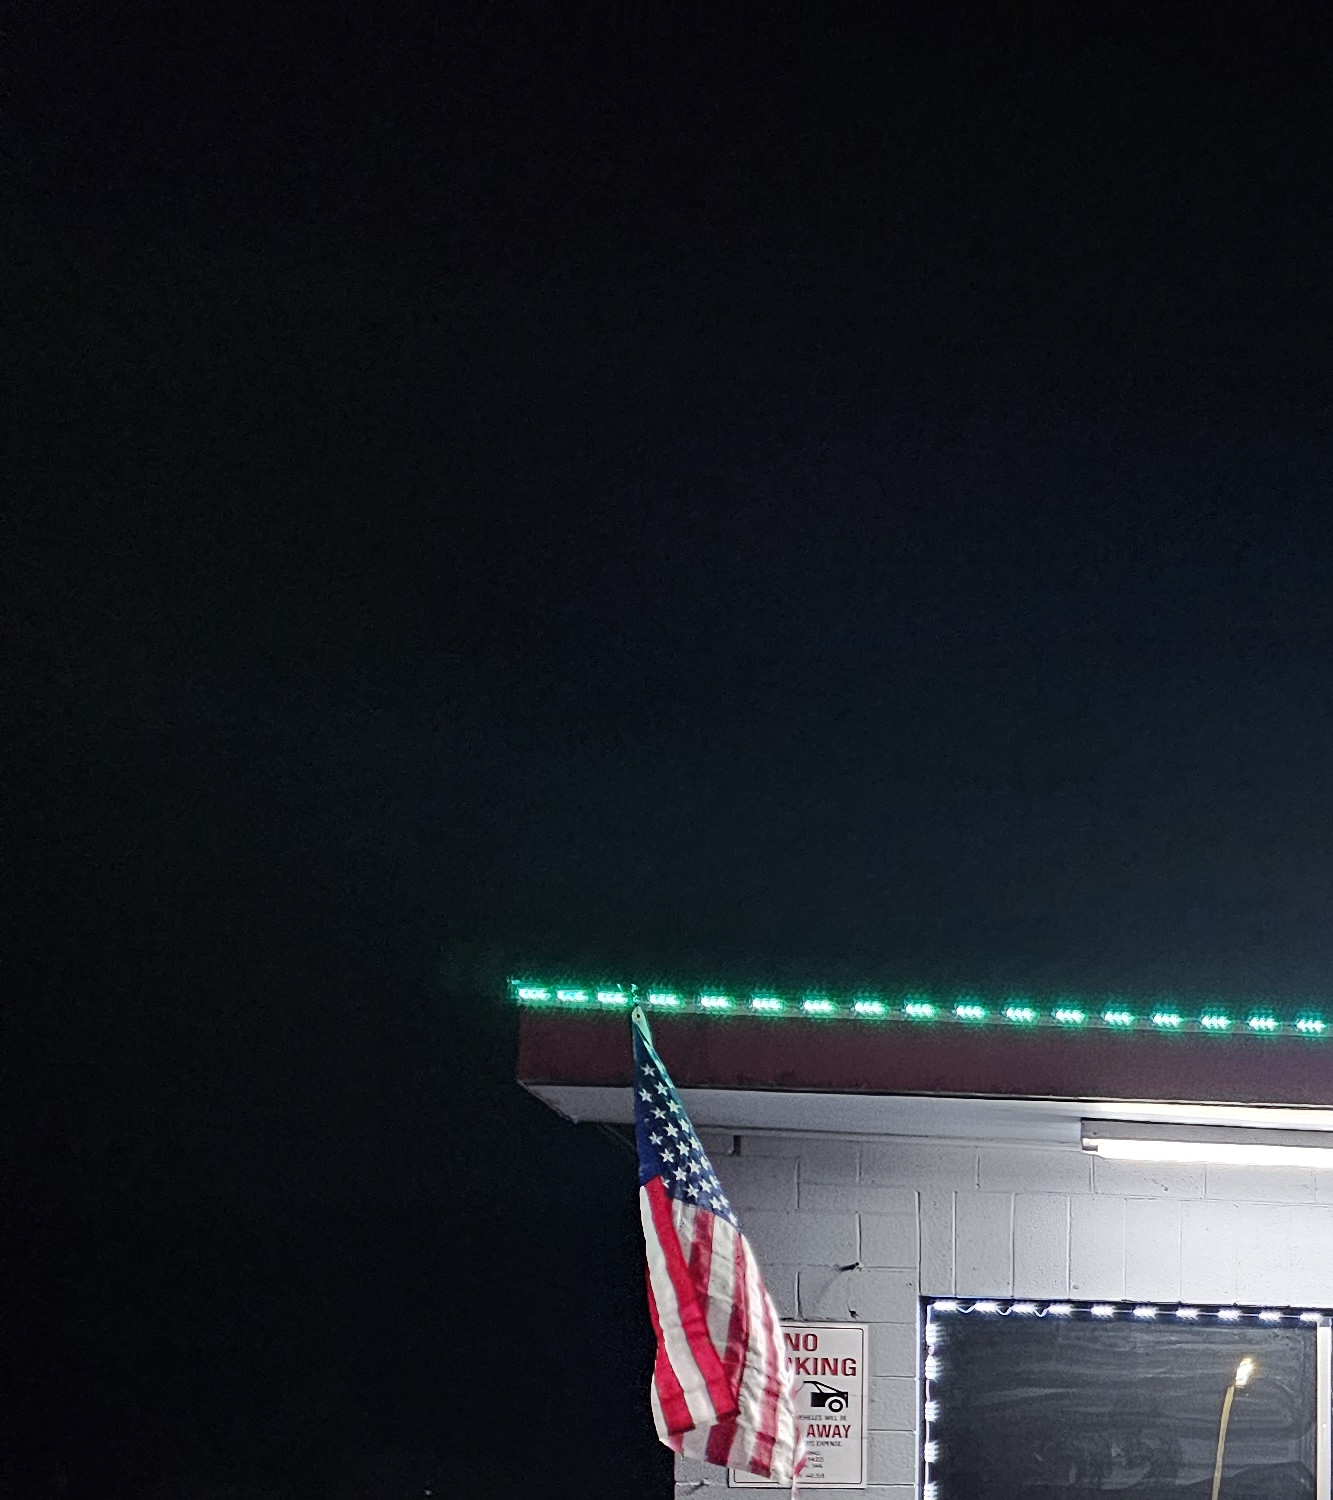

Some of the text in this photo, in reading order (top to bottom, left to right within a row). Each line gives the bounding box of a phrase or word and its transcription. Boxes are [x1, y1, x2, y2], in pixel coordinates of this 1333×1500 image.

[784, 1332, 818, 1352] NO
[788, 1356, 857, 1377] KING
[806, 1424, 852, 1439] AWAY
